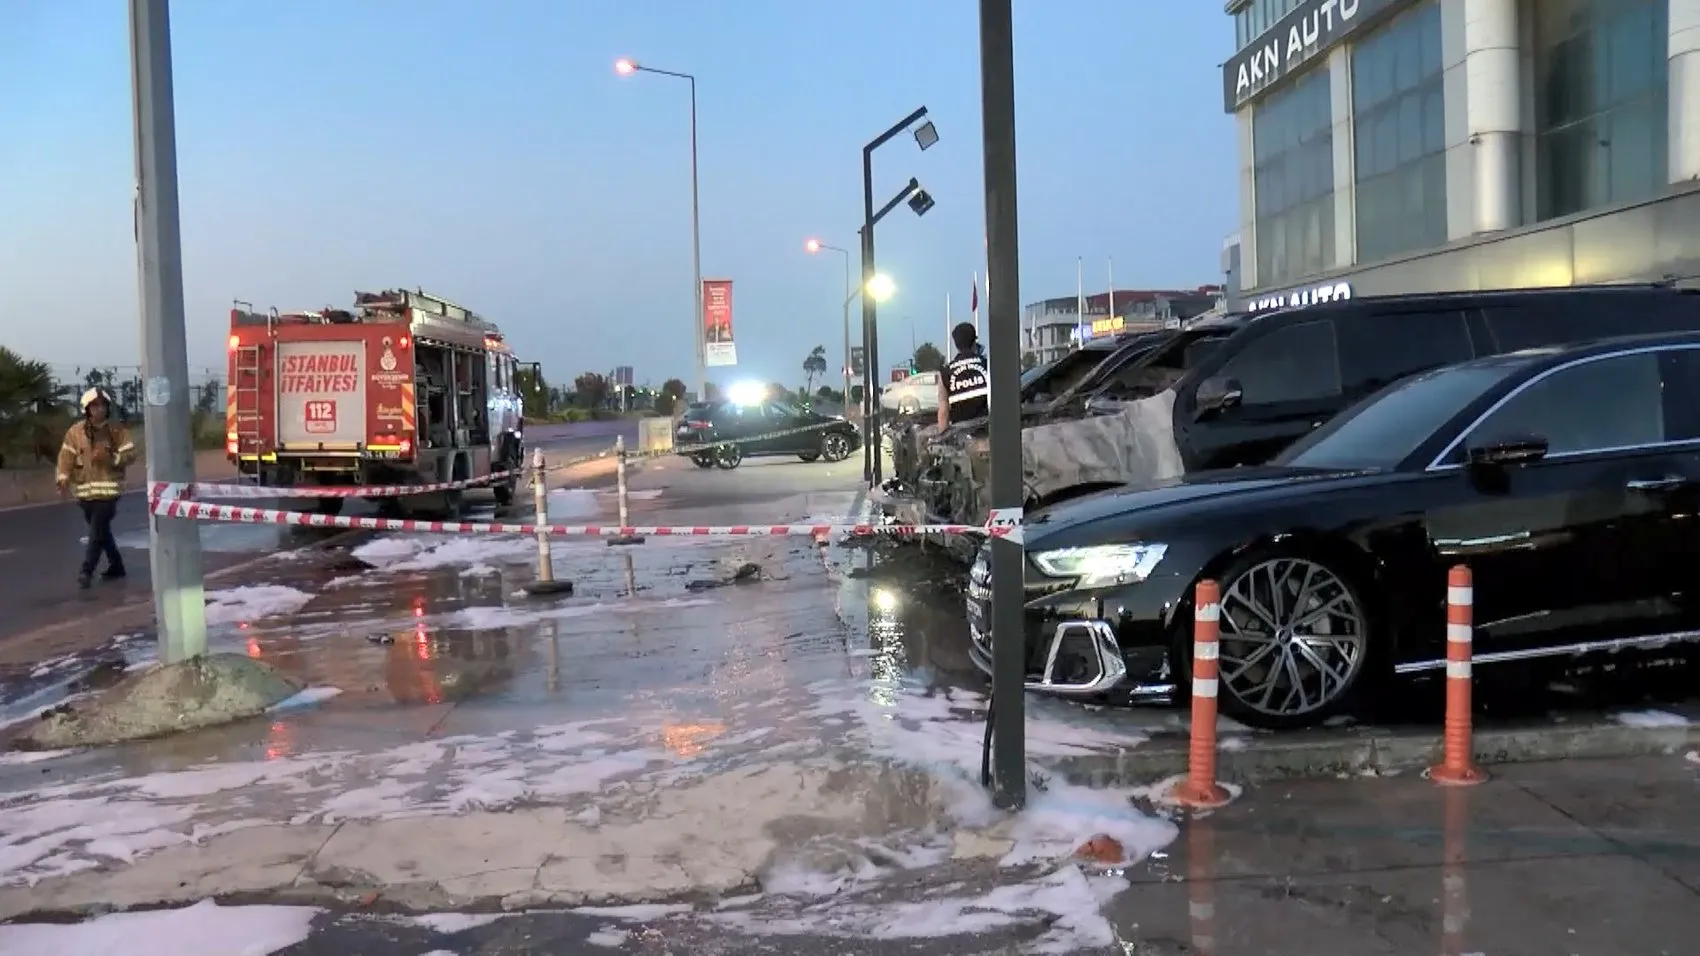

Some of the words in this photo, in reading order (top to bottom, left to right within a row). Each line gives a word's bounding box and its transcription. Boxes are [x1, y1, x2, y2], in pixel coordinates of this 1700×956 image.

[1235, 38, 1279, 95] AKN
[1286, 0, 1359, 61] AUTO
[281, 354, 358, 373] İSTANBUL
[281, 374, 358, 393] İTFAİYESİ
[309, 402, 333, 420] 112
